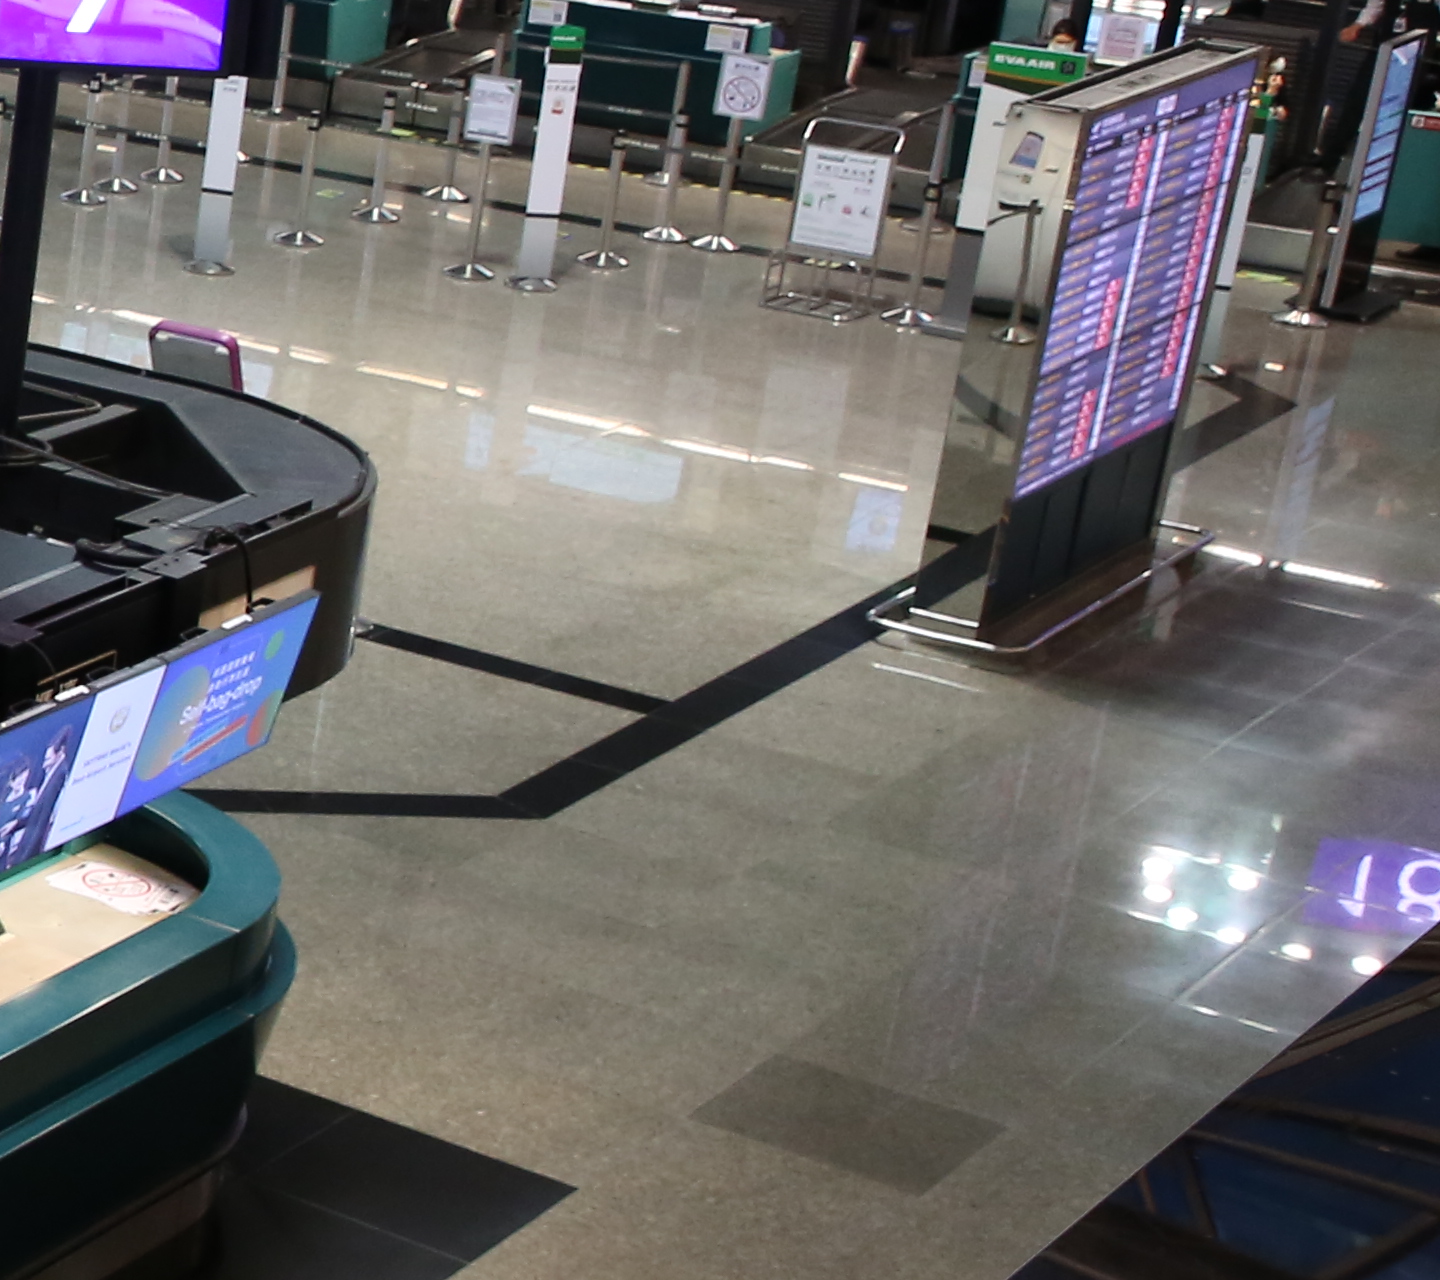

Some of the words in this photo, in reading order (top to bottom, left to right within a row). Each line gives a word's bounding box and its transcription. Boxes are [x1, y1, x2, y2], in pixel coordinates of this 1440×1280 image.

[994, 53, 1026, 66] EVA
[1026, 58, 1057, 71] AIR
[179, 675, 264, 726] Self-bag-drop
